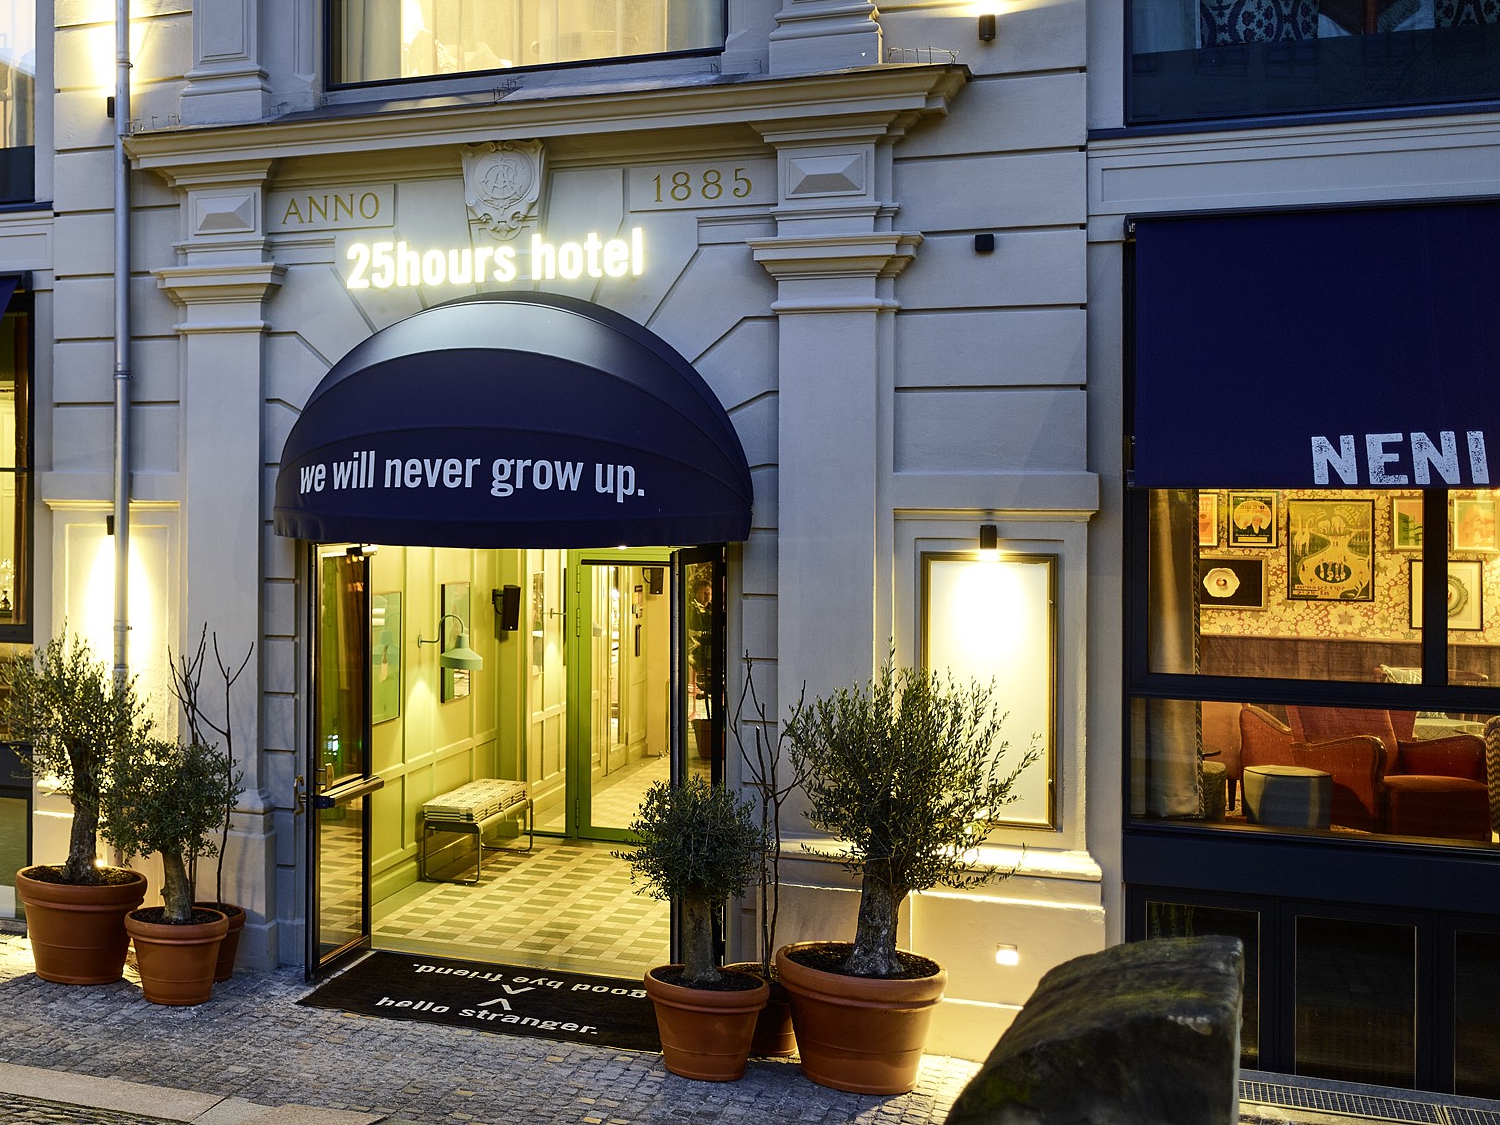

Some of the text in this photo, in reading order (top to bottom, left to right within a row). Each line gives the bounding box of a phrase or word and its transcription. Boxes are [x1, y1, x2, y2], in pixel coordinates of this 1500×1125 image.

[280, 167, 753, 225] ANNO 1885
[346, 227, 644, 290] 25hours hotel
[299, 450, 646, 504] we will never grow up.
[1311, 430, 1490, 485] NENI
[412, 963, 648, 999] good bye friend.
[374, 996, 598, 1035] hello stranger.
